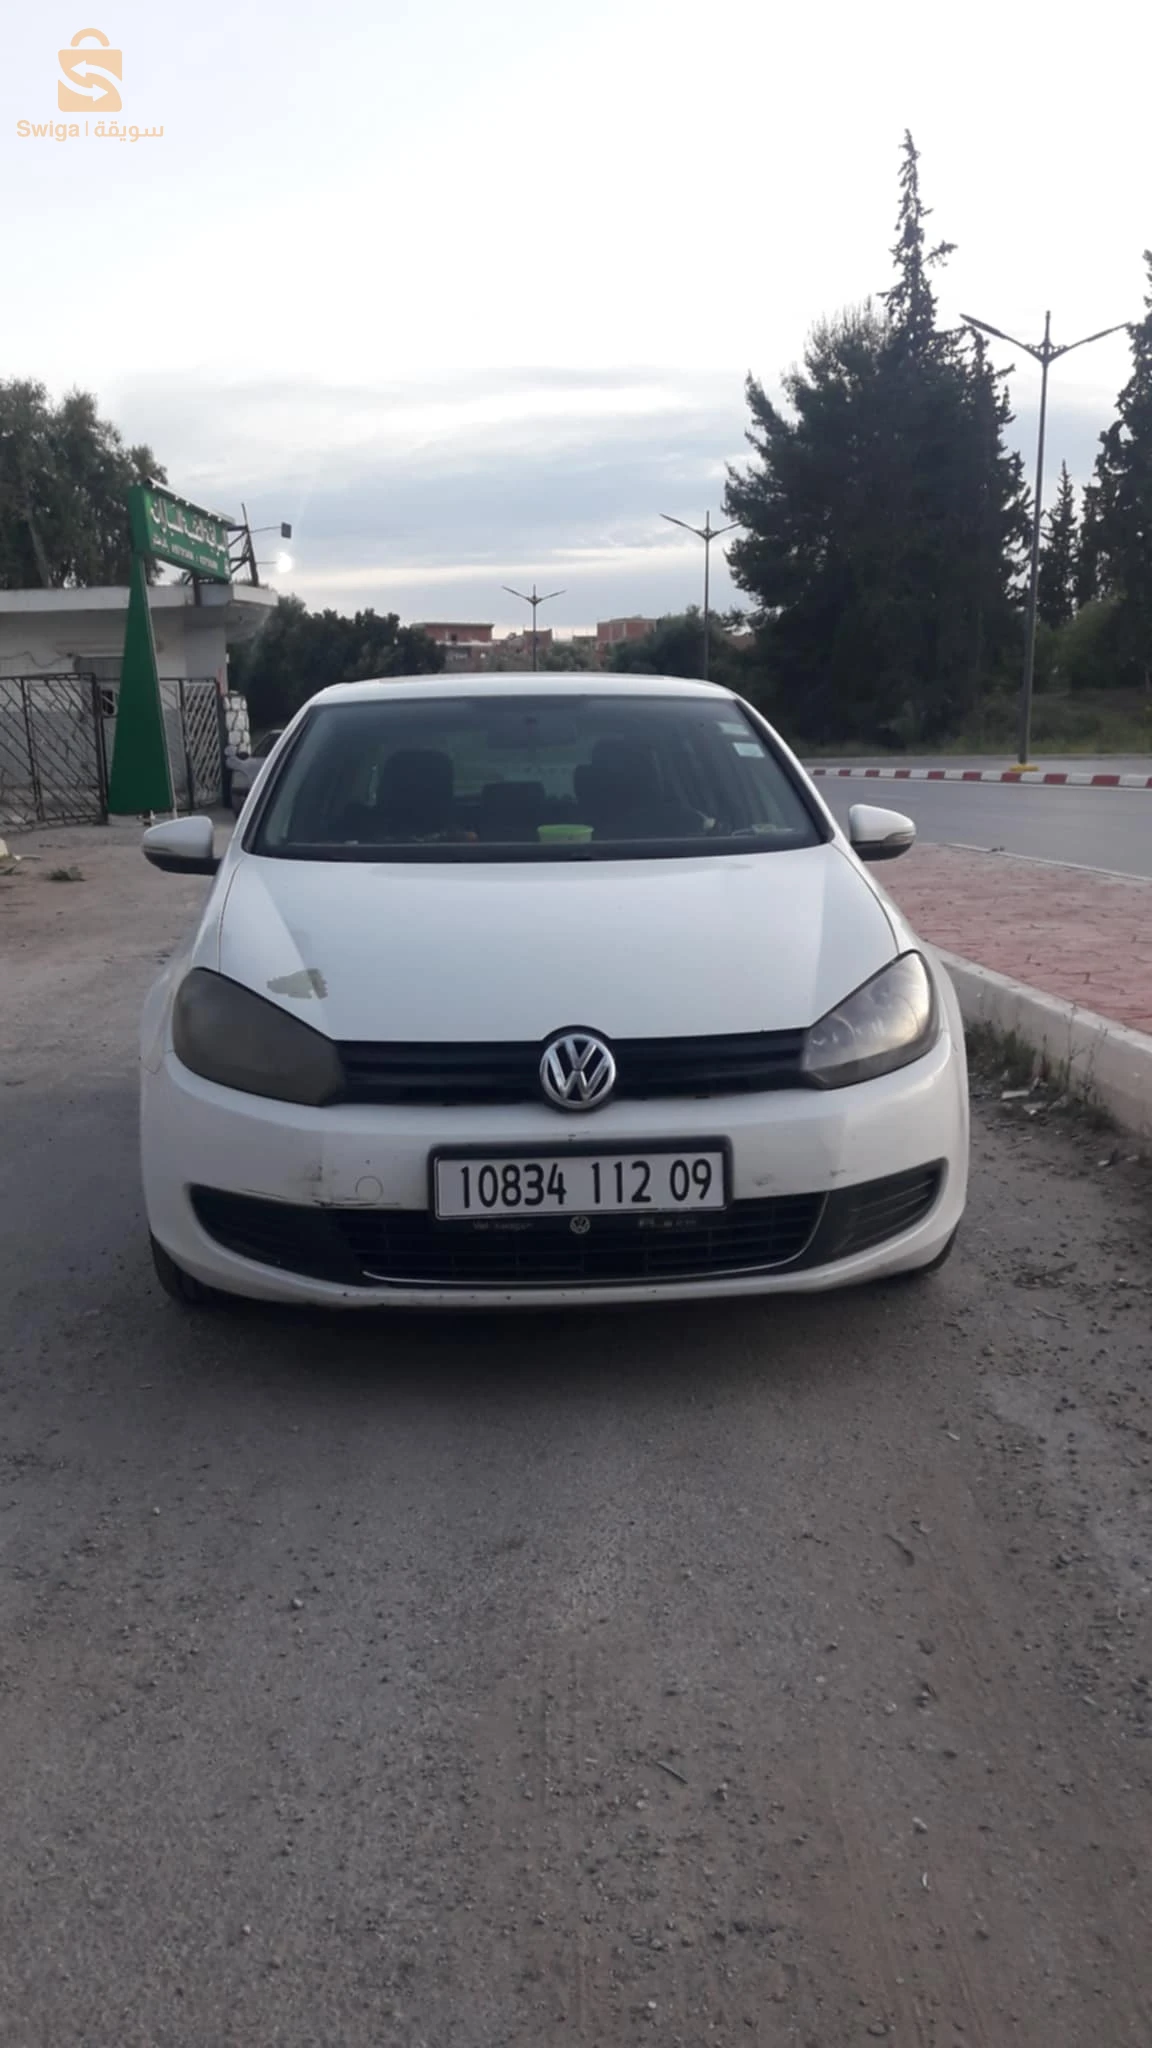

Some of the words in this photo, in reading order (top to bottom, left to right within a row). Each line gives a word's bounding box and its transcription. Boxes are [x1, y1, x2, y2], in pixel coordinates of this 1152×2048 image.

[460, 1162, 567, 1209] 10834
[591, 1160, 652, 1205] 112
[669, 1158, 713, 1202] 09
